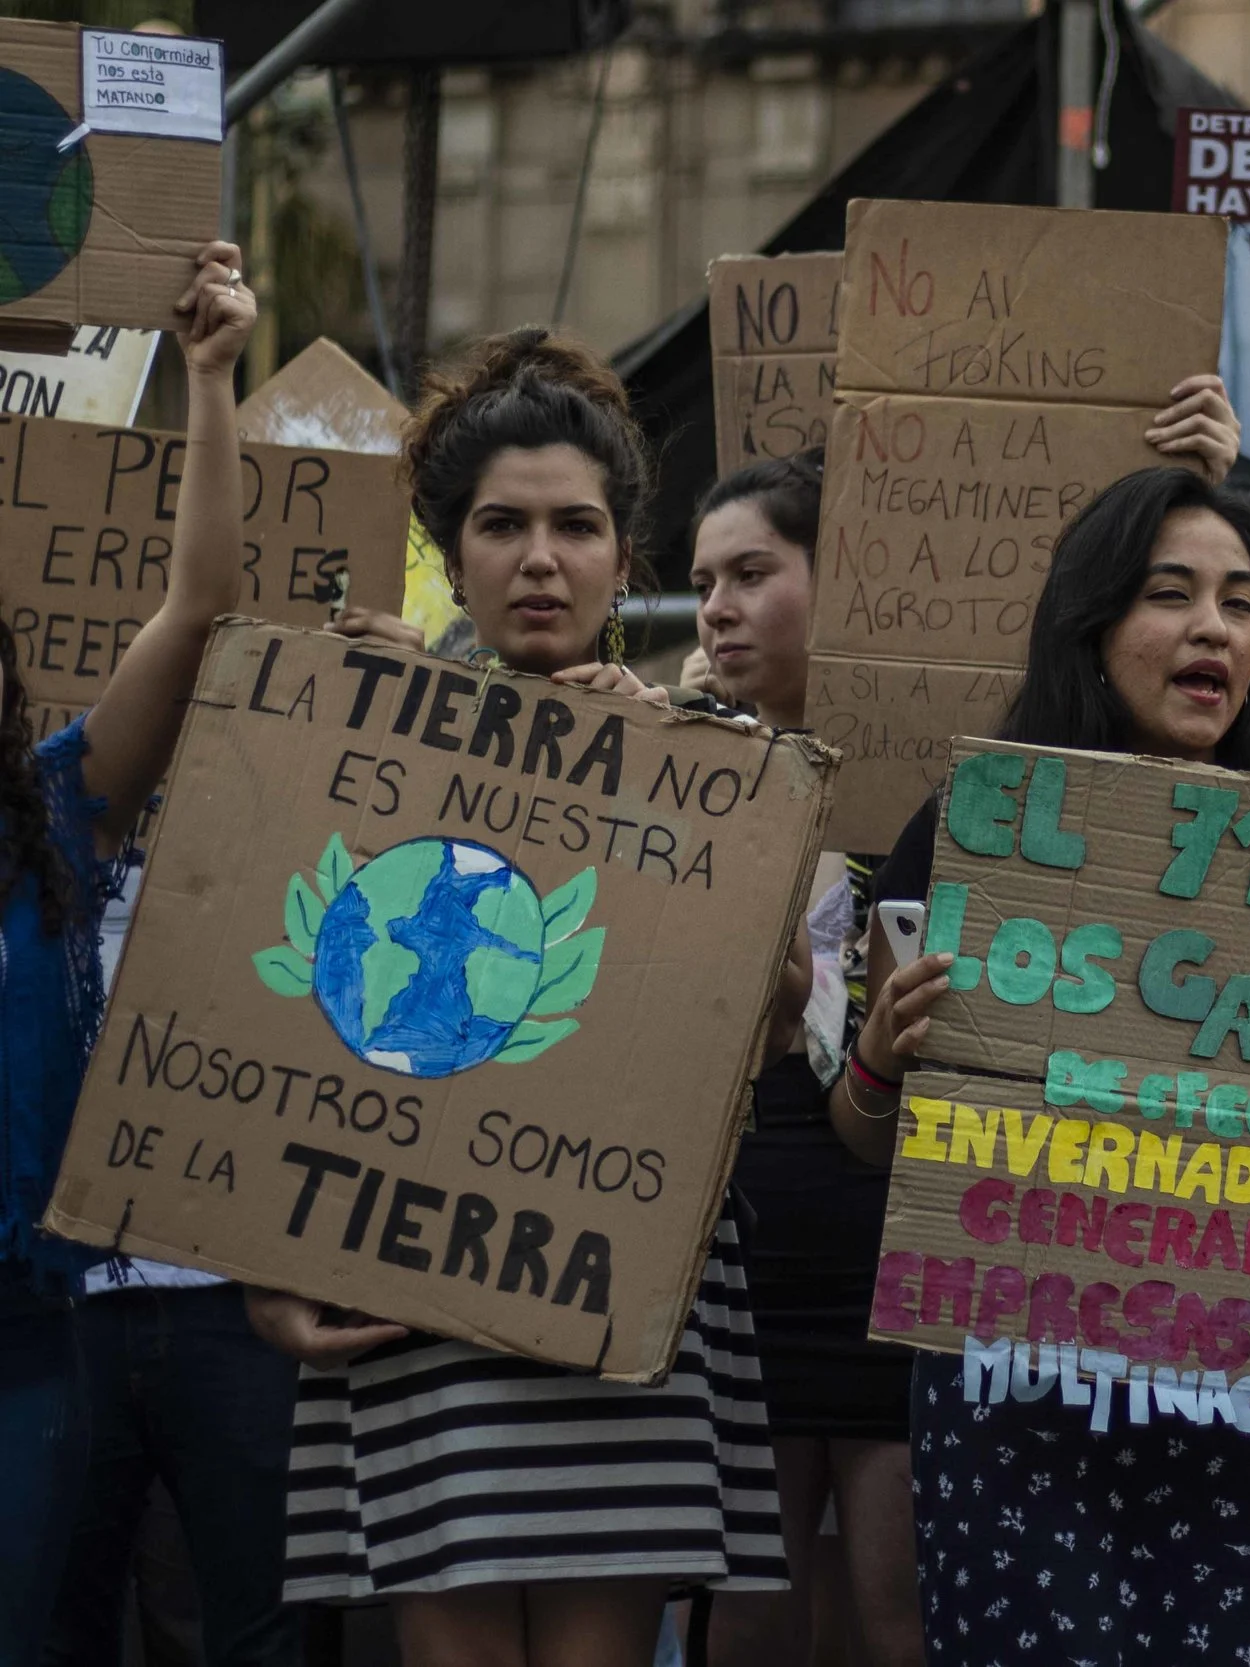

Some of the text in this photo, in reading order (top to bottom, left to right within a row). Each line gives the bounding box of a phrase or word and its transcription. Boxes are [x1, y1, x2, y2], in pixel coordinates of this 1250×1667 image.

[97, 89, 165, 105] MATANDO
[98, 64, 125, 77] nos
[737, 279, 798, 355] NO
[754, 363, 795, 403] LA
[952, 418, 976, 467] A
[1003, 415, 1052, 464] LA
[909, 533, 941, 584] A
[342, 650, 625, 797] TIERRA
[647, 754, 743, 817] NO
[328, 750, 714, 890] ES NUESTRA
[947, 752, 1086, 869] EL
[924, 883, 1123, 1014] LOS
[117, 1010, 667, 1202] NOSOTROS SOMOS
[1045, 1050, 1128, 1114] DE
[107, 1120, 612, 1315] DE LA TIERRA
